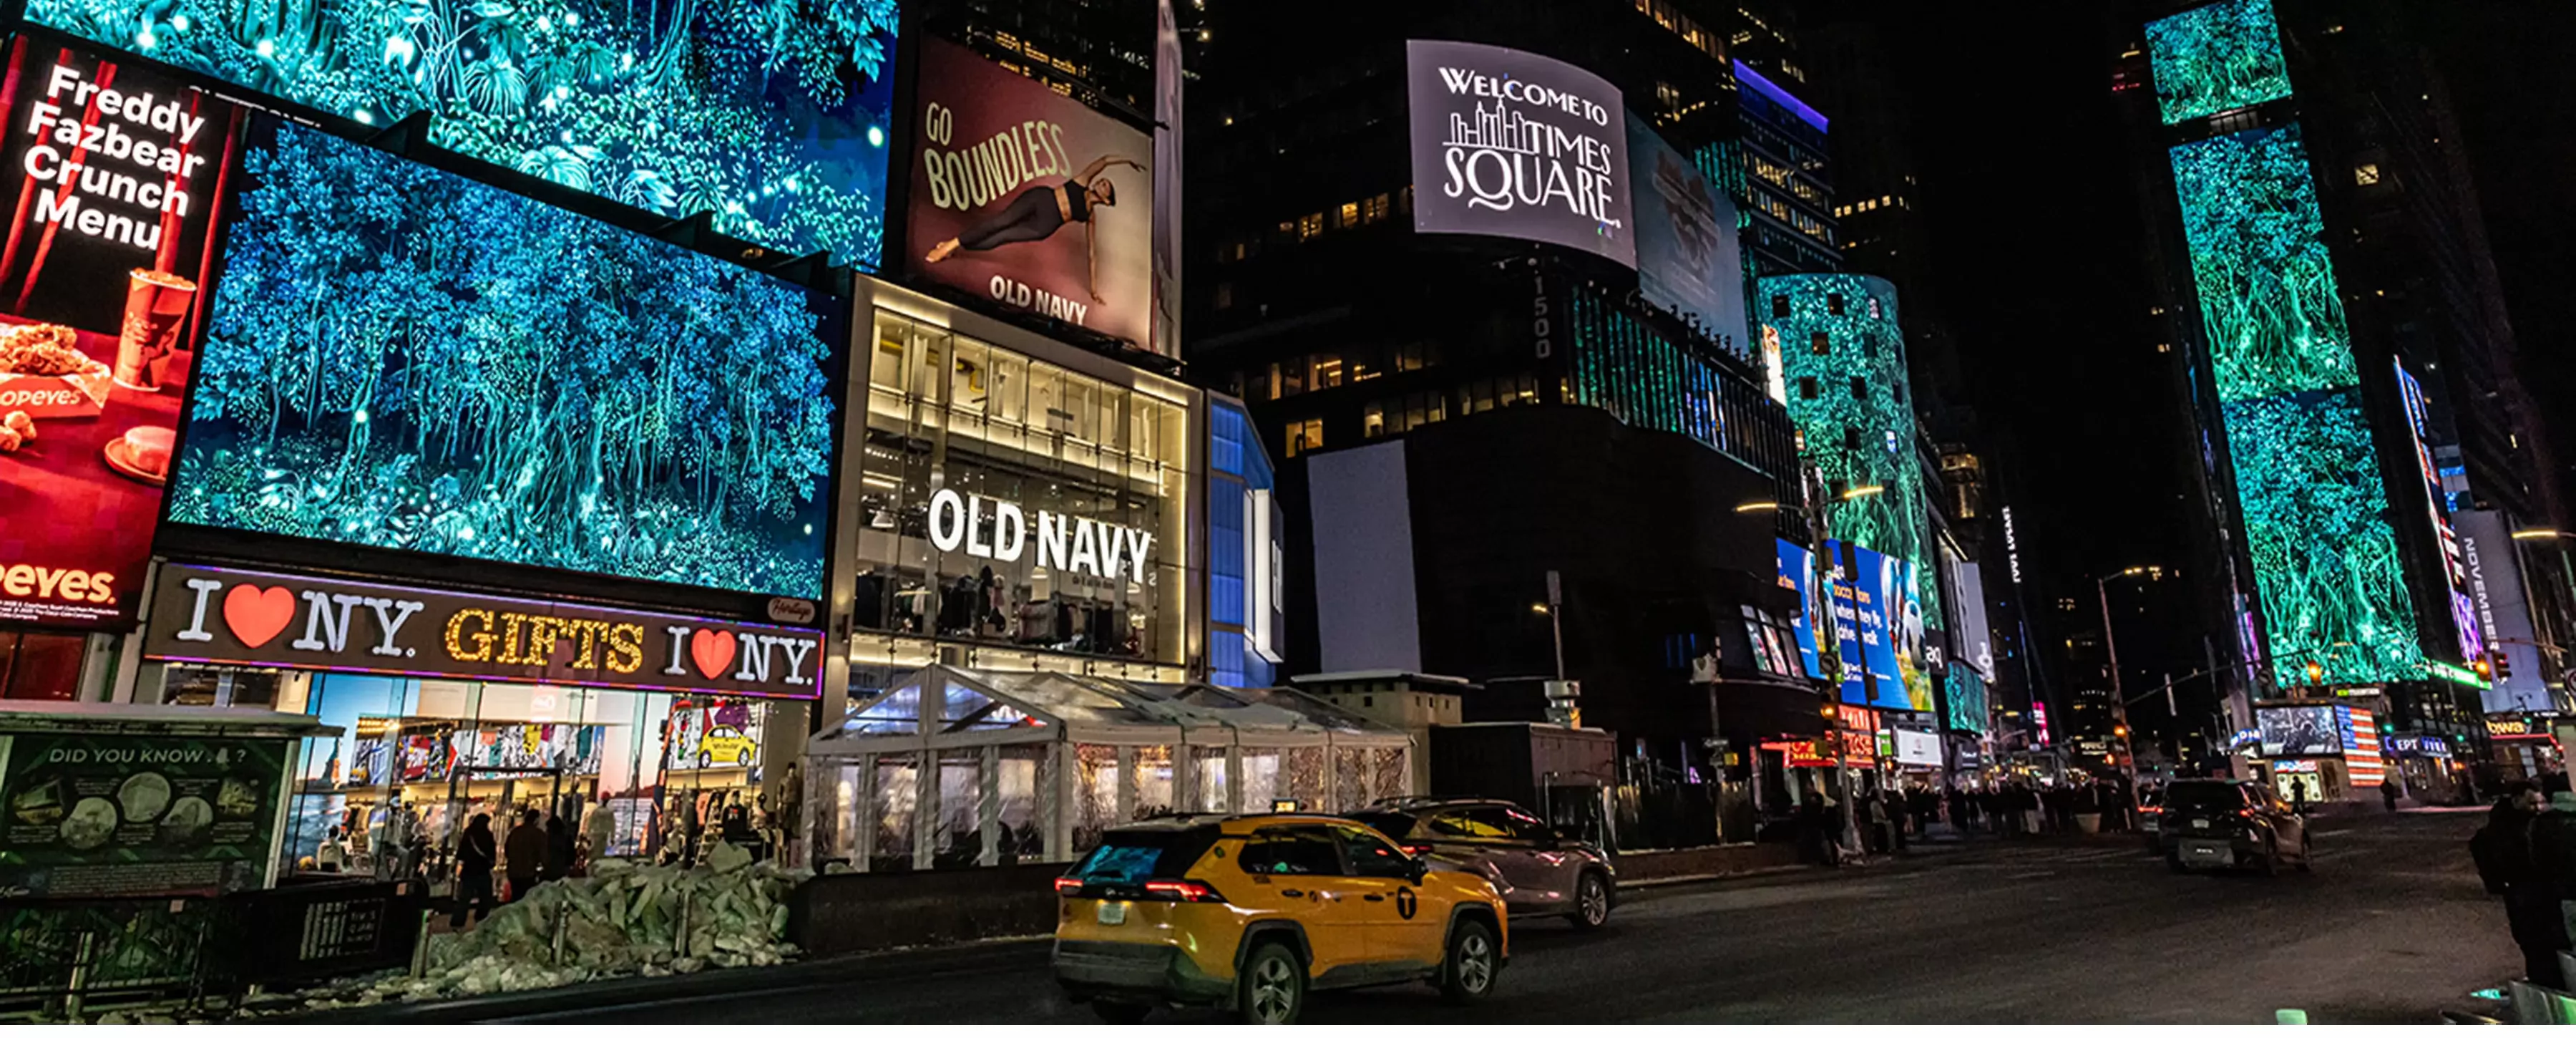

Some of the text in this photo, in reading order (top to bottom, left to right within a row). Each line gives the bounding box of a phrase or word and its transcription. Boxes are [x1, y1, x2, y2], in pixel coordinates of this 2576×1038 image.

[47, 64, 205, 144] Freddy
[926, 102, 952, 146] GO
[1438, 67, 1608, 126] WELCOME TO
[28, 100, 205, 178] Fazbear
[924, 120, 1072, 211] BOUNDLESS
[1525, 120, 1611, 175] TIMES
[24, 145, 189, 217] Crunch
[34, 188, 161, 251] Menu
[990, 276, 1087, 326] OLD NAVY
[1534, 276, 1551, 359] 1500
[929, 489, 1152, 584] OLD NAVY
[177, 578, 223, 641] I
[445, 607, 643, 673] GIFTS
[665, 626, 691, 675] I
[2464, 538, 2501, 651] NOVEMBER
[49, 749, 87, 763] DID
[93, 749, 136, 763] YOU
[1401, 893, 1413, 916] T
